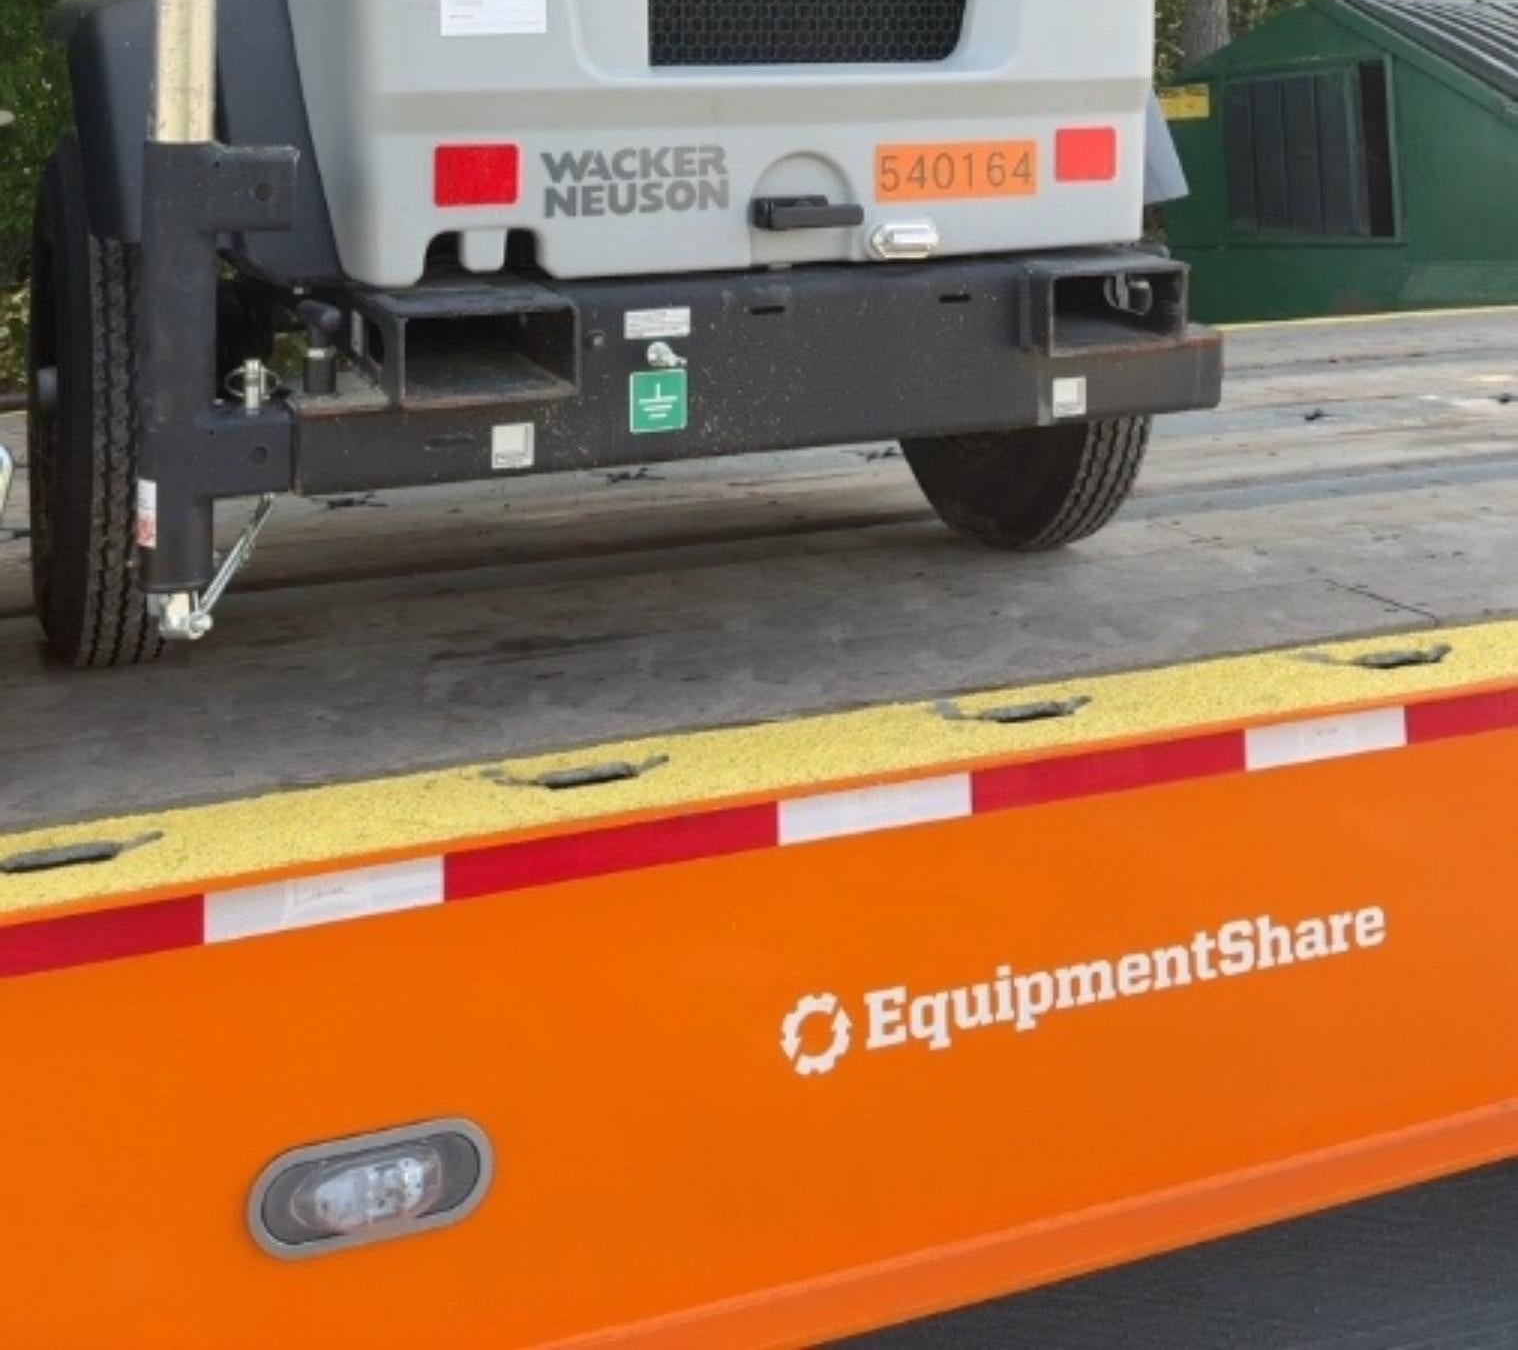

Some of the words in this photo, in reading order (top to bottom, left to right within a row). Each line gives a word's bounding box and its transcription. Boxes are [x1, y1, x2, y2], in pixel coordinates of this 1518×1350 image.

[540, 145, 729, 184] WACKER
[879, 150, 1034, 193] 540164
[543, 179, 730, 219] NEUSON
[864, 904, 1387, 1052] EquipmentShare
